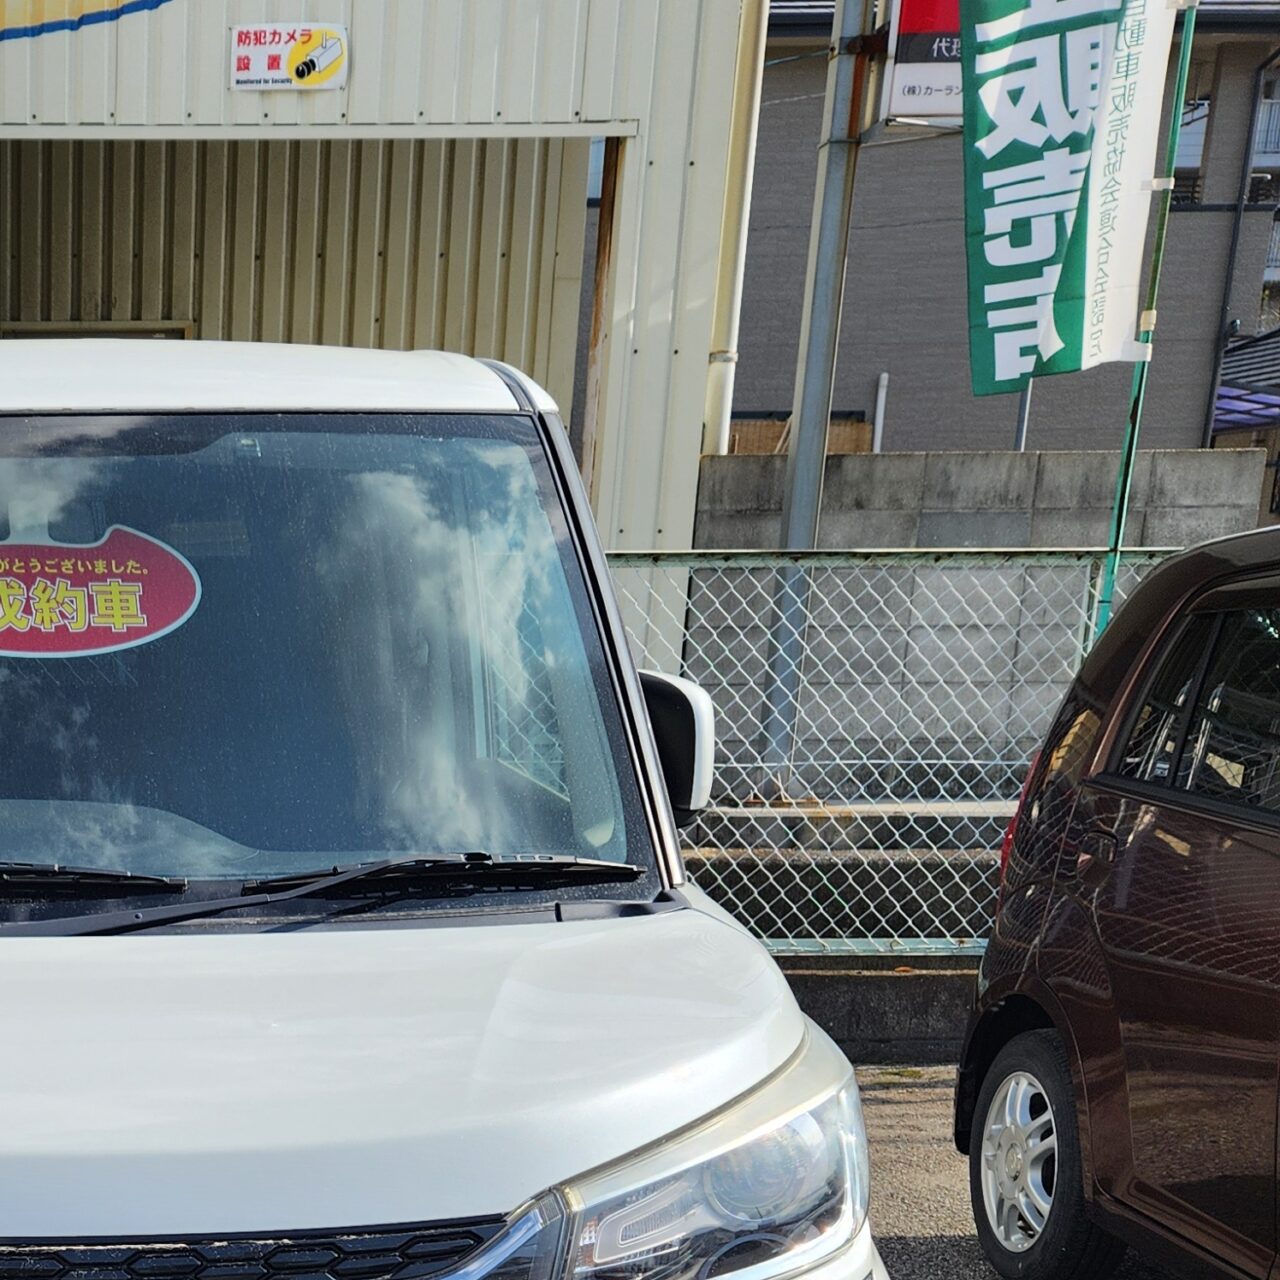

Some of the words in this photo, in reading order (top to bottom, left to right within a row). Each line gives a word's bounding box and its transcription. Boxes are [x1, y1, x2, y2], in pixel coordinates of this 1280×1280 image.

[237, 29, 312, 47] 防犯カメラ
